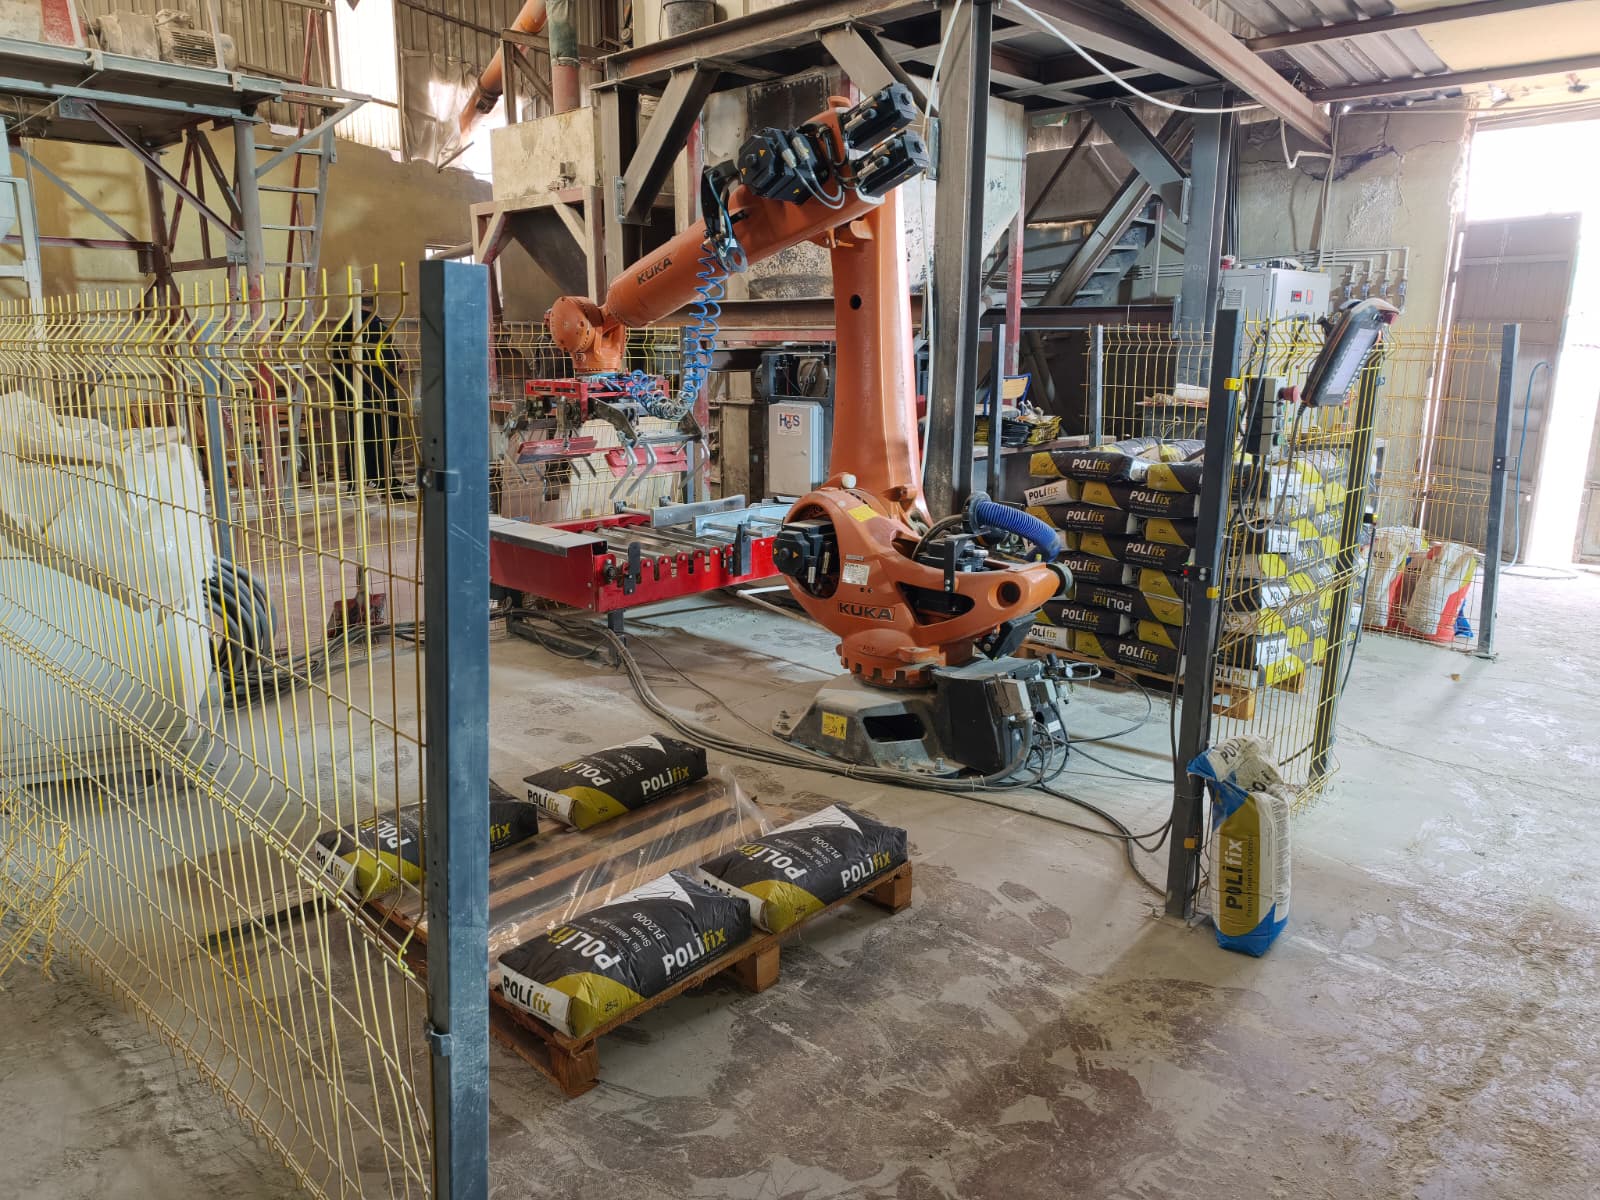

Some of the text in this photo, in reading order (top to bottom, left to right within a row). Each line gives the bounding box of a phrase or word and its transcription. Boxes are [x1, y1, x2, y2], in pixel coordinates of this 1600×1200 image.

[637, 257, 672, 285] KUKA
[839, 603, 893, 620] KUKA
[633, 912, 666, 941] PL2000
